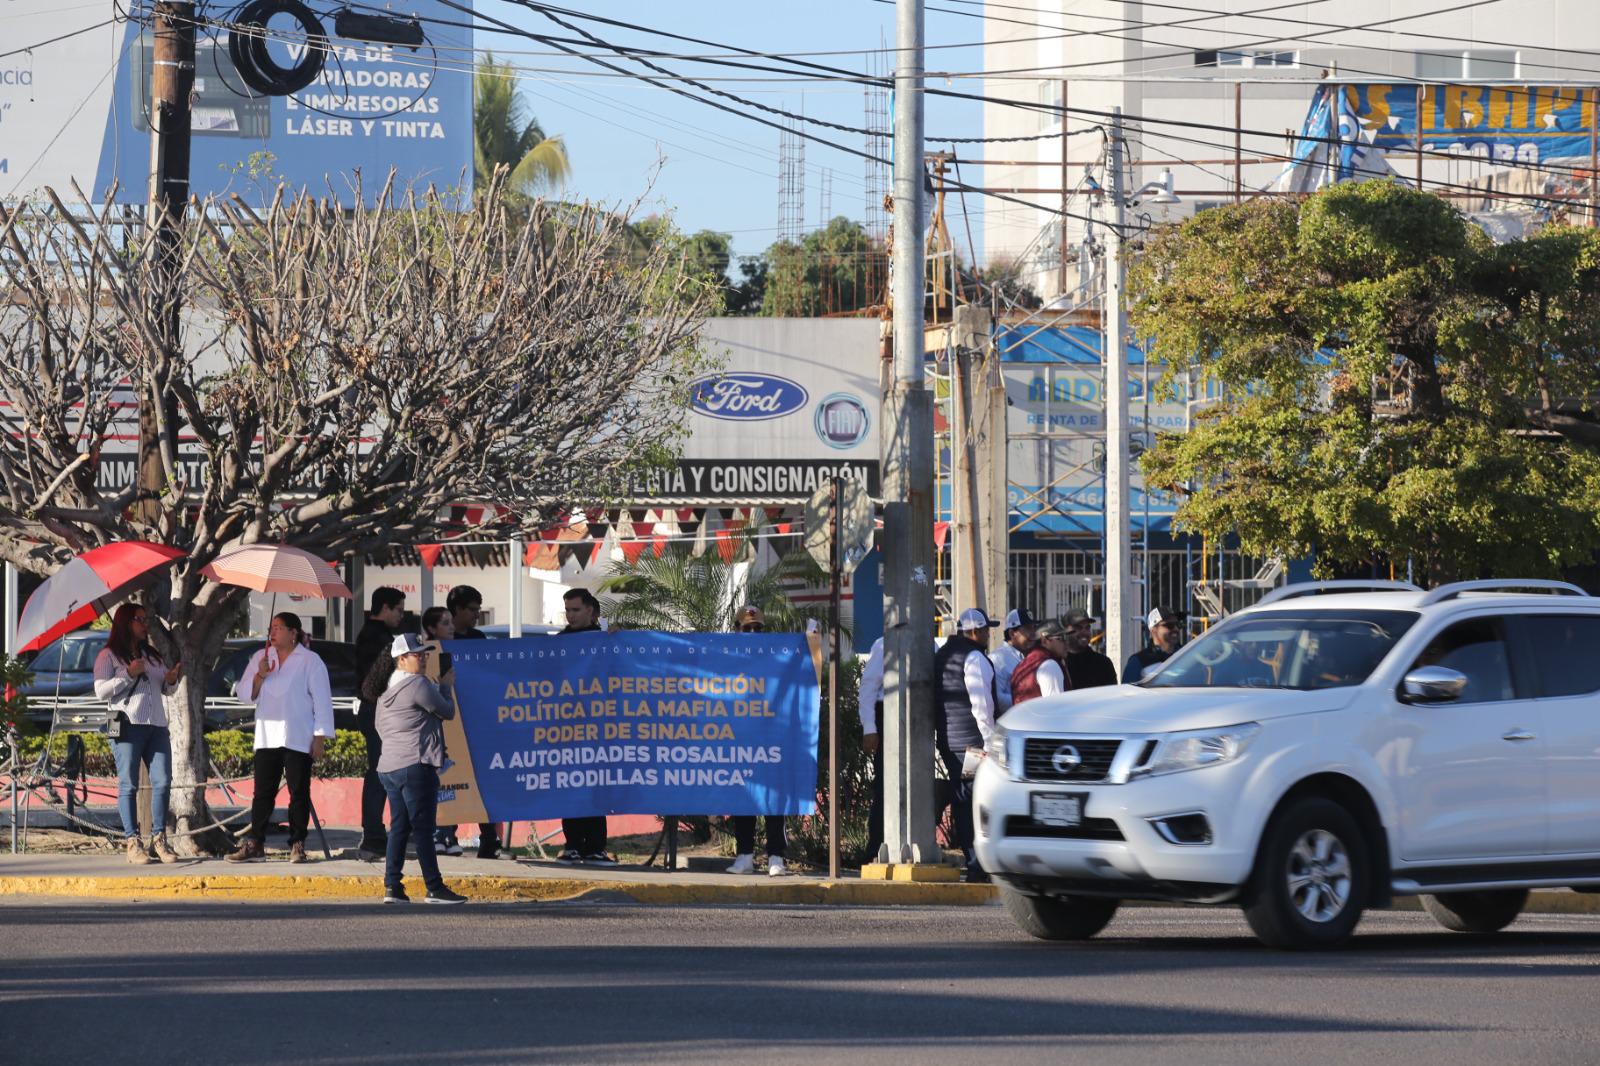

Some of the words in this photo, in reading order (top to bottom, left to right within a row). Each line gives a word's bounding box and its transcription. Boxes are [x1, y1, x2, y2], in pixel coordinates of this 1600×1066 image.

[286, 44, 359, 61] VTA
[365, 46, 393, 62] DE
[286, 95, 299, 110] E
[305, 95, 440, 113] IMPRESORAS
[286, 115, 353, 136] LÁSER
[360, 120, 375, 136] Y
[382, 121, 445, 138] TINTA
[706, 379, 783, 412] Ford
[828, 409, 860, 434] FIAT
[1027, 414, 1075, 425] RENTA
[1080, 415, 1098, 425] DE
[690, 466, 705, 492] Y
[453, 648, 567, 662] UNIVERSIDAD
[579, 645, 673, 656] AUTÓNOMA
[688, 646, 707, 655] DE
[722, 646, 801, 655] SINALOA
[504, 680, 554, 700] ALTO
[559, 679, 574, 697] A
[578, 677, 604, 695] LA
[607, 672, 766, 695] PERSECUCIÓN
[497, 699, 586, 723] POLÍTICA
[591, 700, 617, 718] DE
[623, 700, 652, 717] LA
[657, 700, 729, 717] MAFIA
[734, 700, 775, 717] DEL
[533, 723, 599, 744] PODER
[604, 722, 632, 740] DE
[636, 723, 736, 740] SINALOA
[489, 752, 505, 770] A
[508, 745, 651, 769] AUTORIDADES
[656, 745, 782, 763] ROSALINAS
[556, 768, 659, 789] RODILLAS
